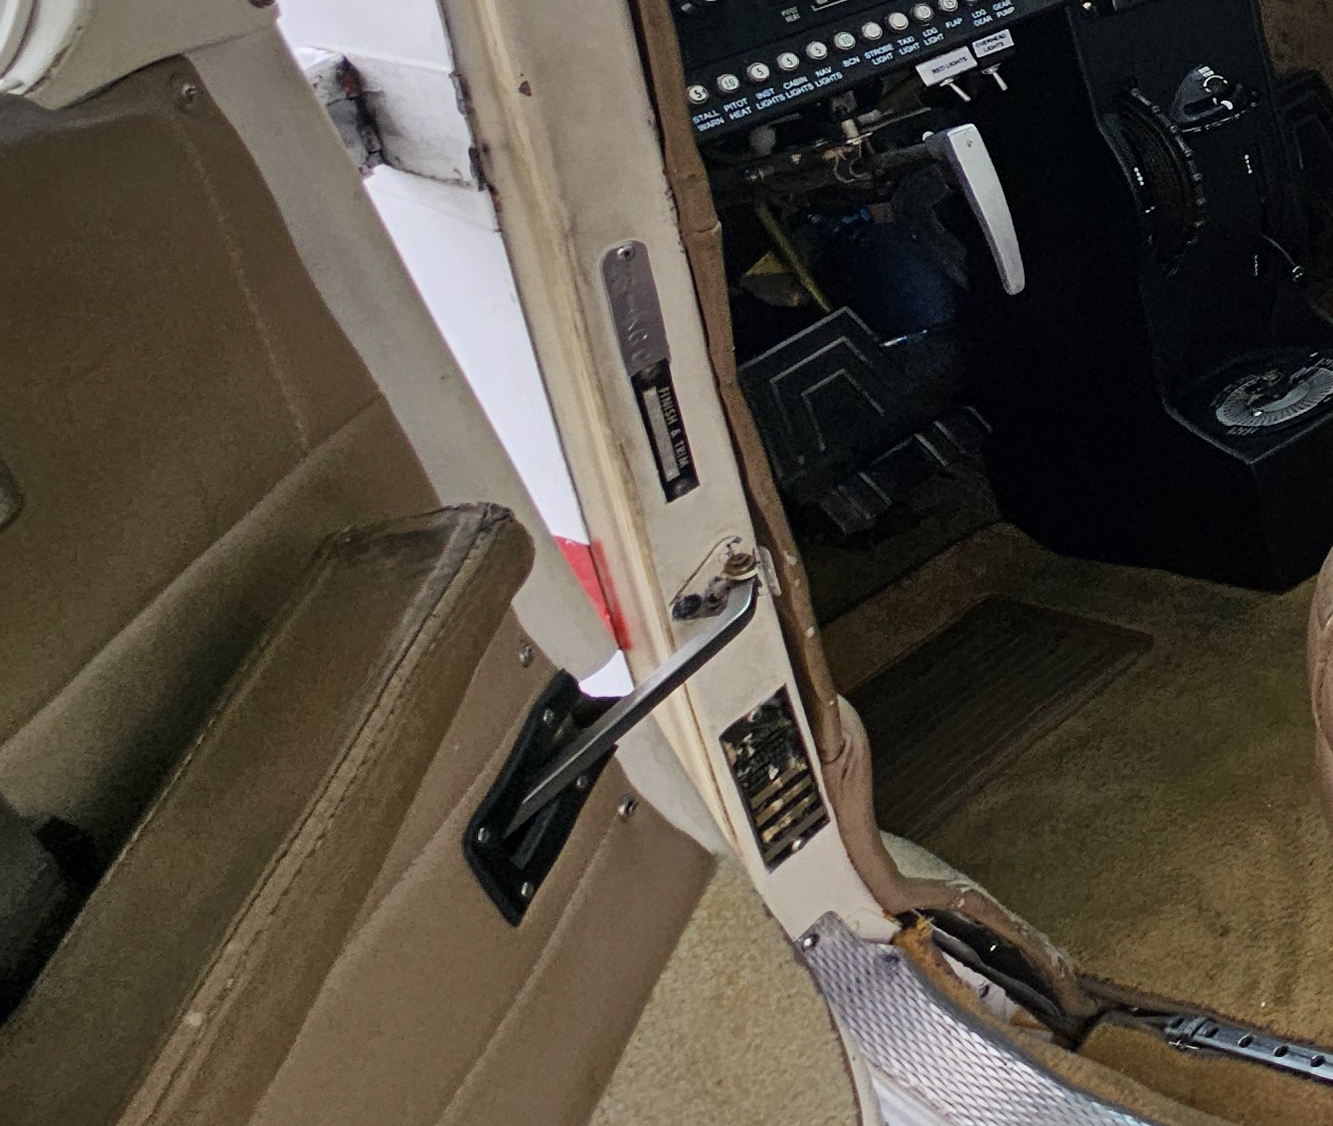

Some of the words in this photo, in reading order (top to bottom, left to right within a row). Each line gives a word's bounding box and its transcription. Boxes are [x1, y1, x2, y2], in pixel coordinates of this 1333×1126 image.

[971, 8, 987, 19] LDG
[945, 17, 963, 29] FLAP
[973, 16, 993, 27] GEAR
[922, 27, 939, 38] LDG
[897, 36, 916, 47] TAXI
[923, 33, 945, 47] LIGHT
[975, 33, 1007, 48] OVERHEAD
[815, 46, 822, 54] 5
[864, 43, 894, 59] STROBE
[899, 42, 921, 56] LIGHT
[983, 41, 1005, 53] LIGHTS
[786, 57, 793, 66] 5
[842, 56, 861, 68] BCN
[872, 52, 894, 65] LIGHT
[931, 64, 945, 74] RED
[946, 56, 968, 70] LIGHTS
[756, 68, 764, 76] 5
[815, 66, 832, 78] NAV
[723, 79, 736, 89] 10
[783, 75, 808, 90] CABIN
[814, 71, 843, 88] LIGHTS
[694, 89, 703, 99] 5
[756, 87, 775, 100] INST
[785, 81, 815, 99] LIGHTS
[723, 97, 749, 112] PITOT
[756, 93, 786, 110] LIGHTS
[692, 109, 720, 124] STALL
[729, 107, 753, 120] HEAT
[697, 117, 725, 131] WARN
[658, 387, 679, 425] FINISH
[674, 441, 690, 468] TRIM
